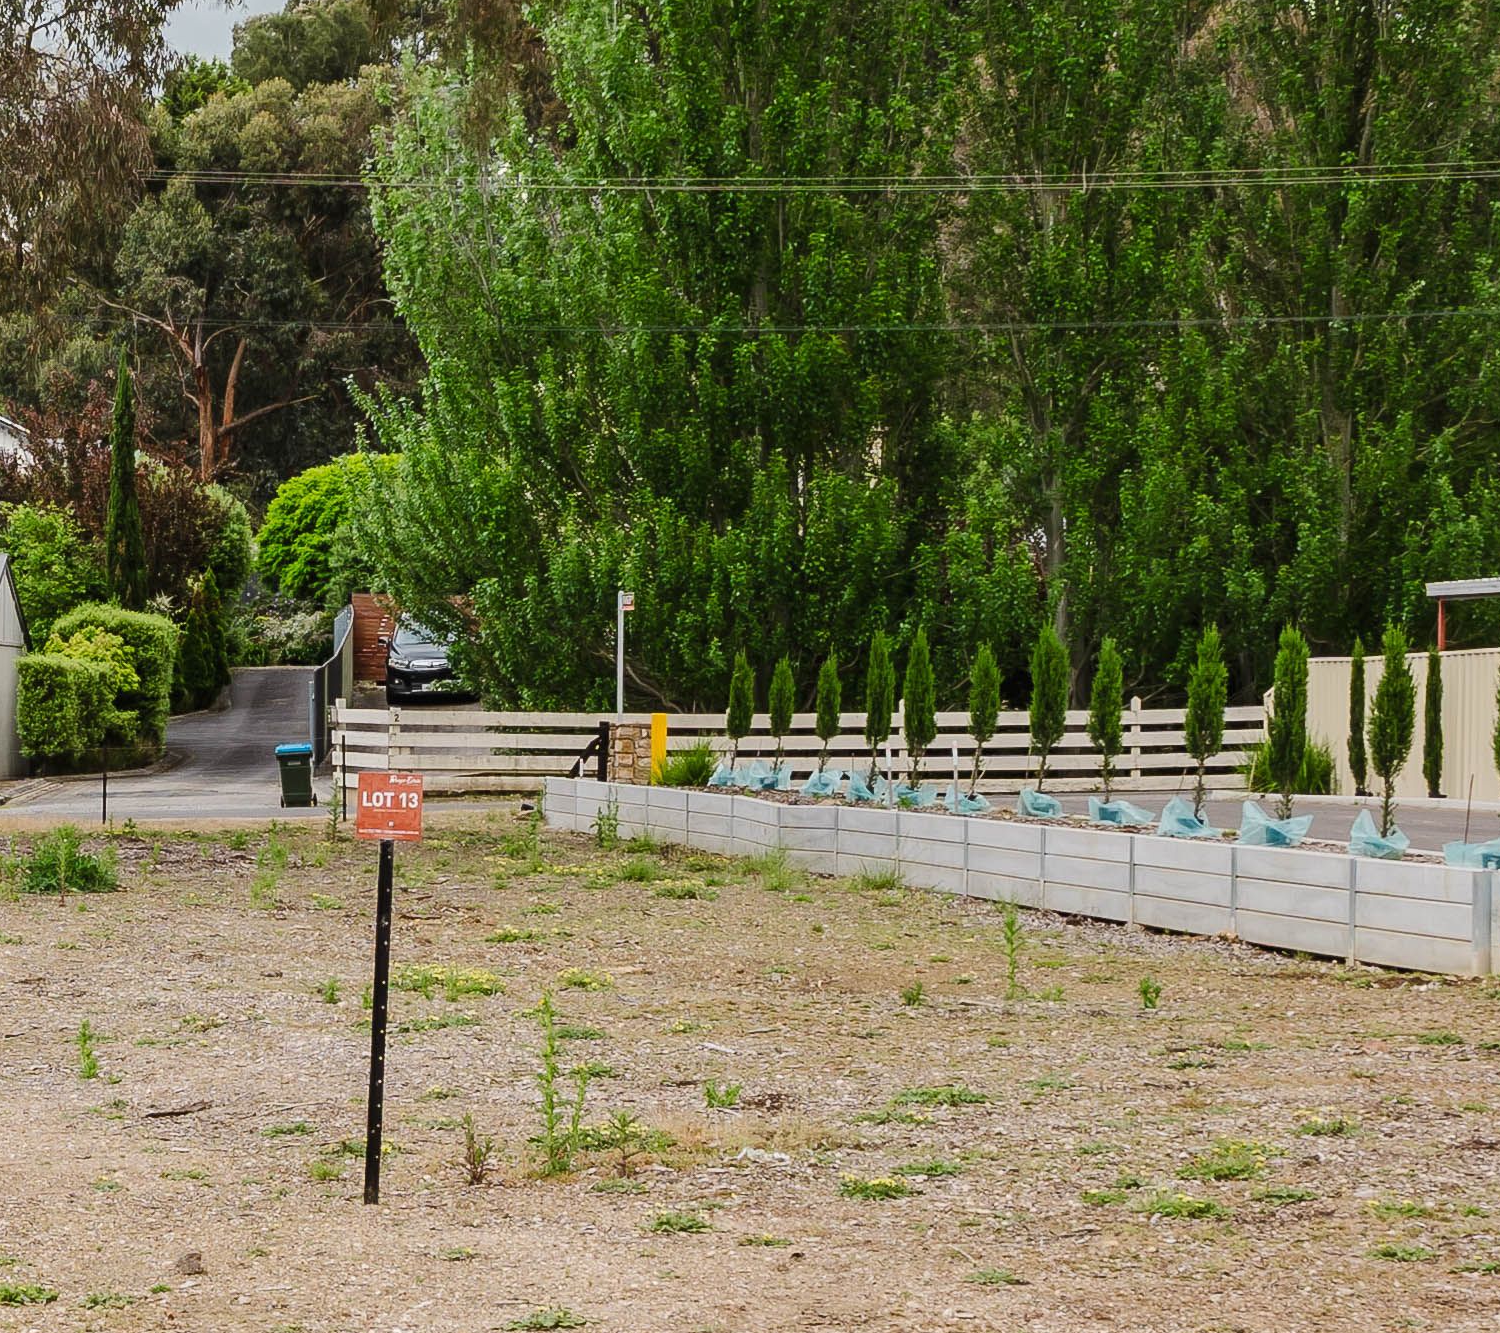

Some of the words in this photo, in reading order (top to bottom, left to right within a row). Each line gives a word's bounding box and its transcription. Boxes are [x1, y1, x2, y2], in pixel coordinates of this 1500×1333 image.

[394, 713, 400, 723] 2
[362, 791, 395, 808] LOT
[399, 792, 419, 809] 13
